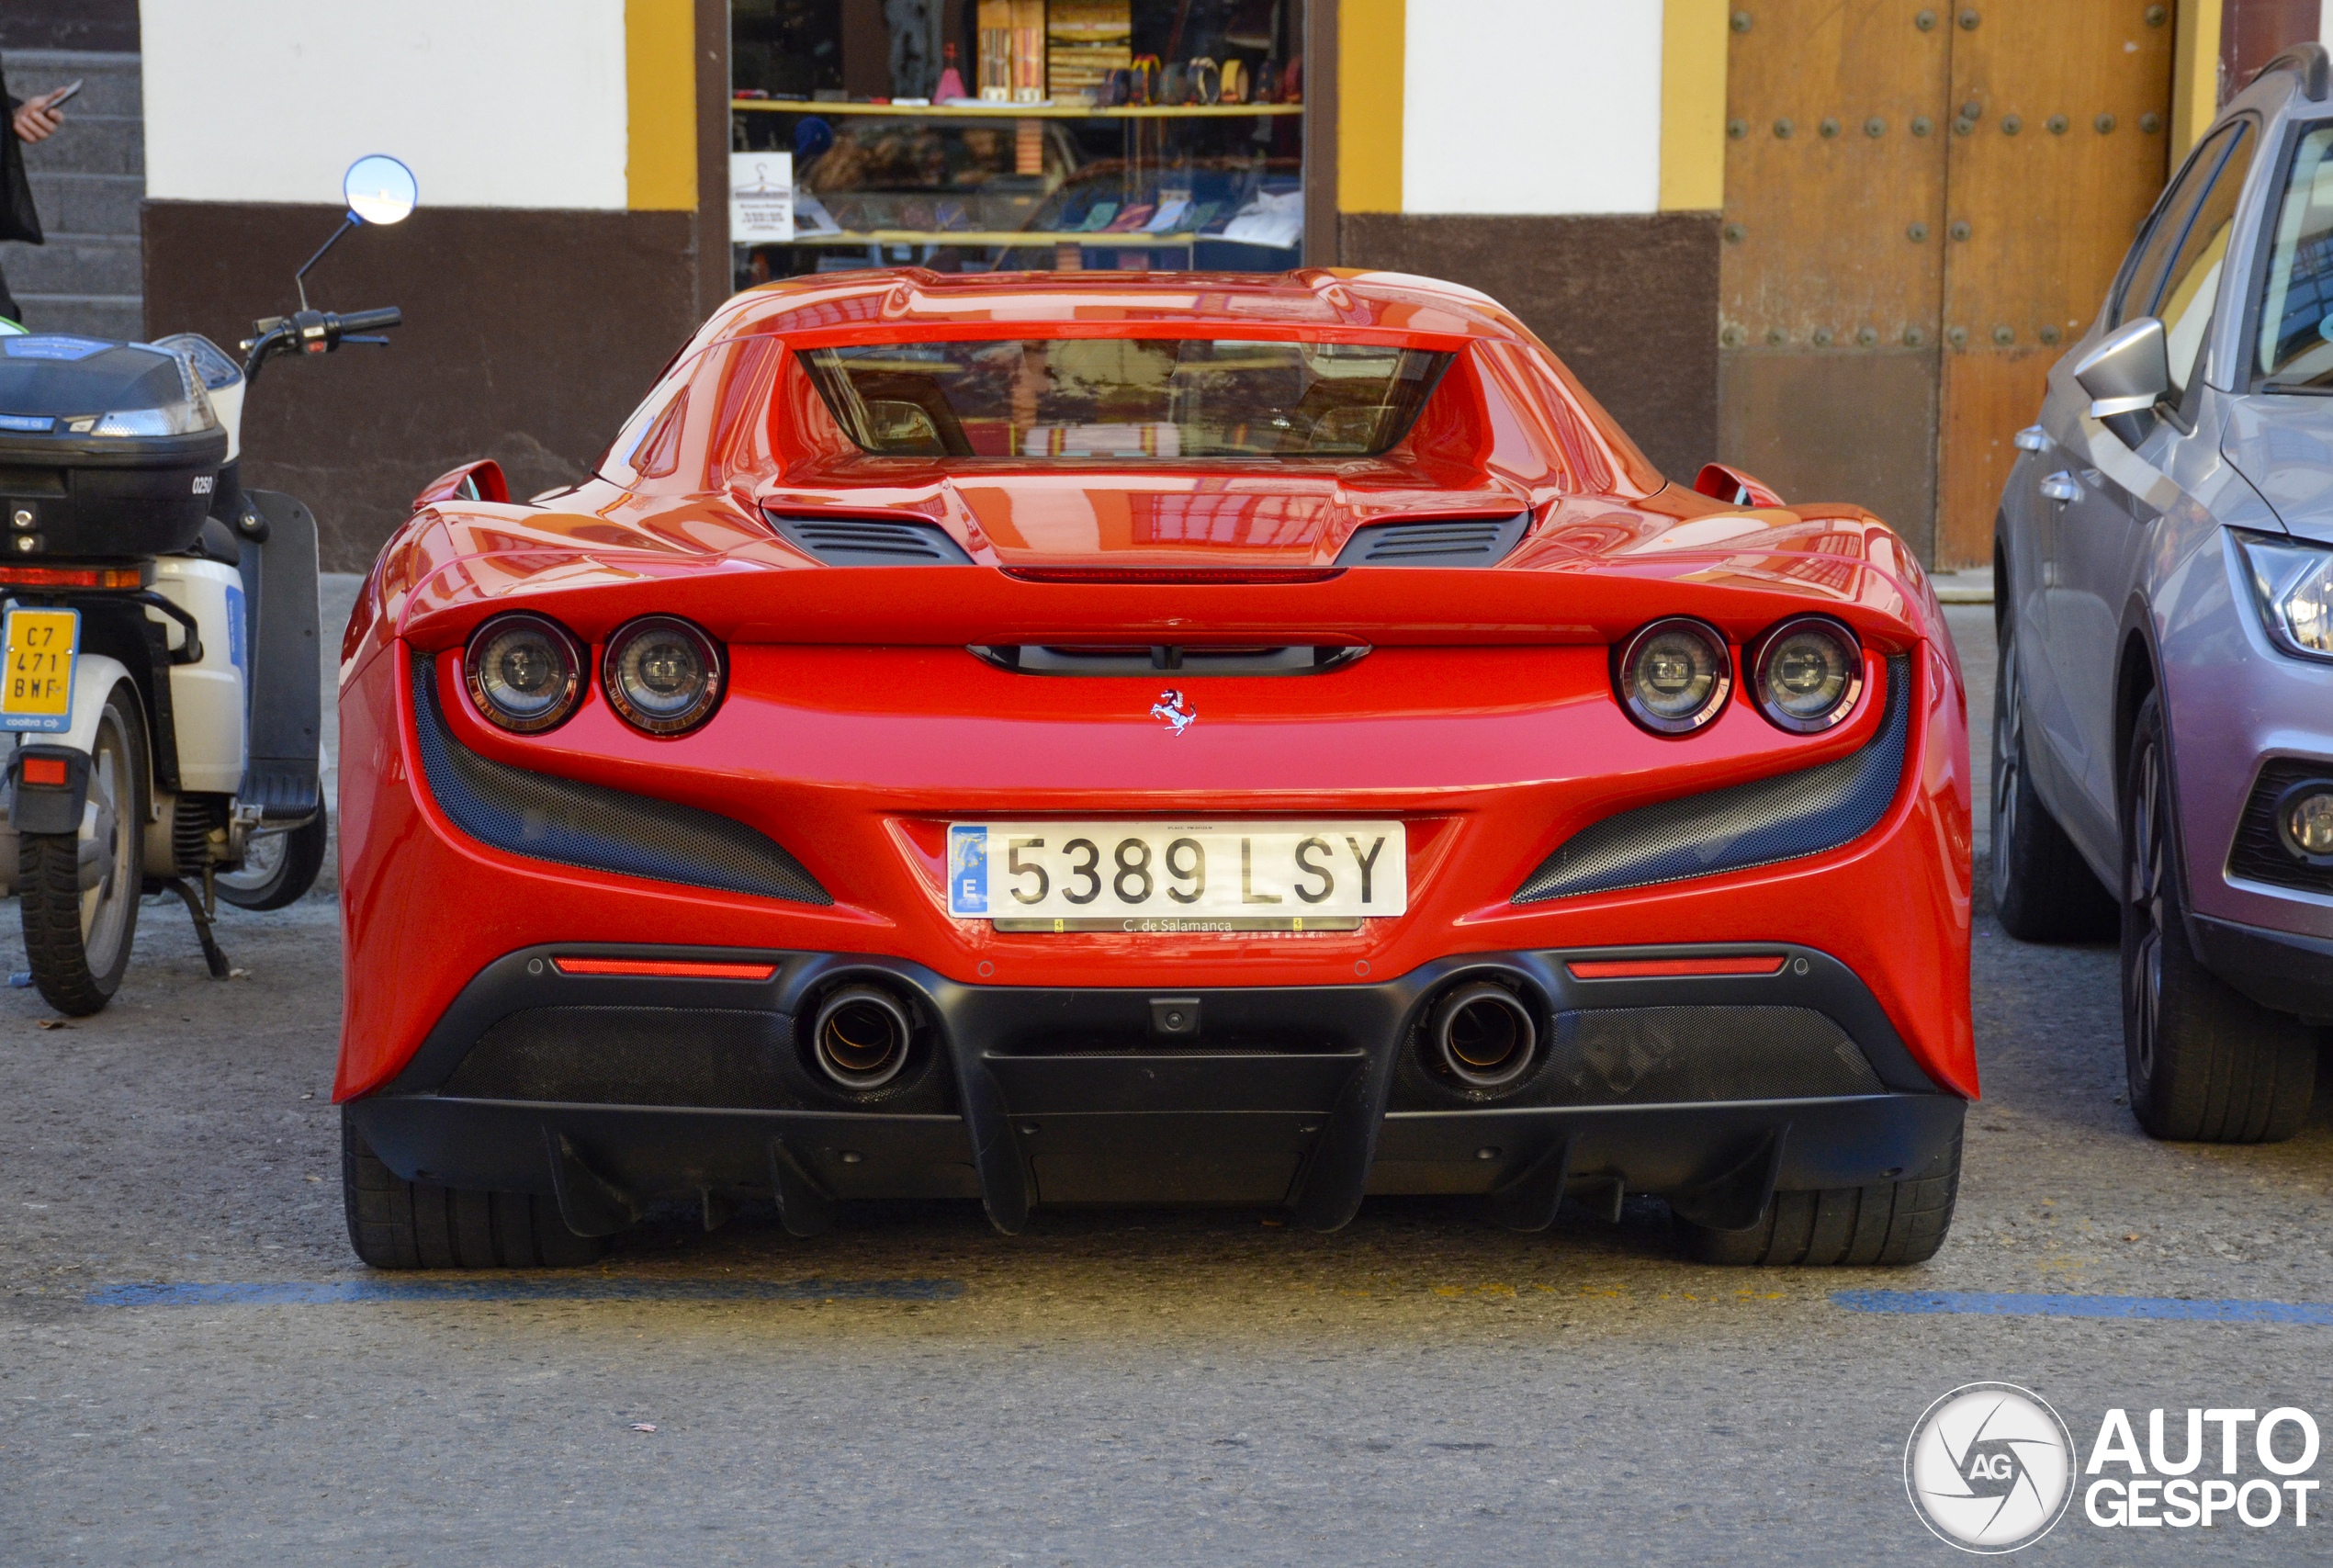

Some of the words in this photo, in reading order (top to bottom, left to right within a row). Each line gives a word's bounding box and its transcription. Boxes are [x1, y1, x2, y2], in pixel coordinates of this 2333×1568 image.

[192, 476, 213, 494] 0250
[27, 627, 54, 647] C7
[17, 653, 57, 672] 471
[6, 717, 41, 728] cooltra
[1007, 837, 1208, 905] 5389
[1241, 837, 1386, 904] LSY
[963, 879, 976, 897] E
[1122, 919, 1137, 931] C.
[1142, 919, 1157, 931] de
[1161, 919, 1233, 931] Salamanca
